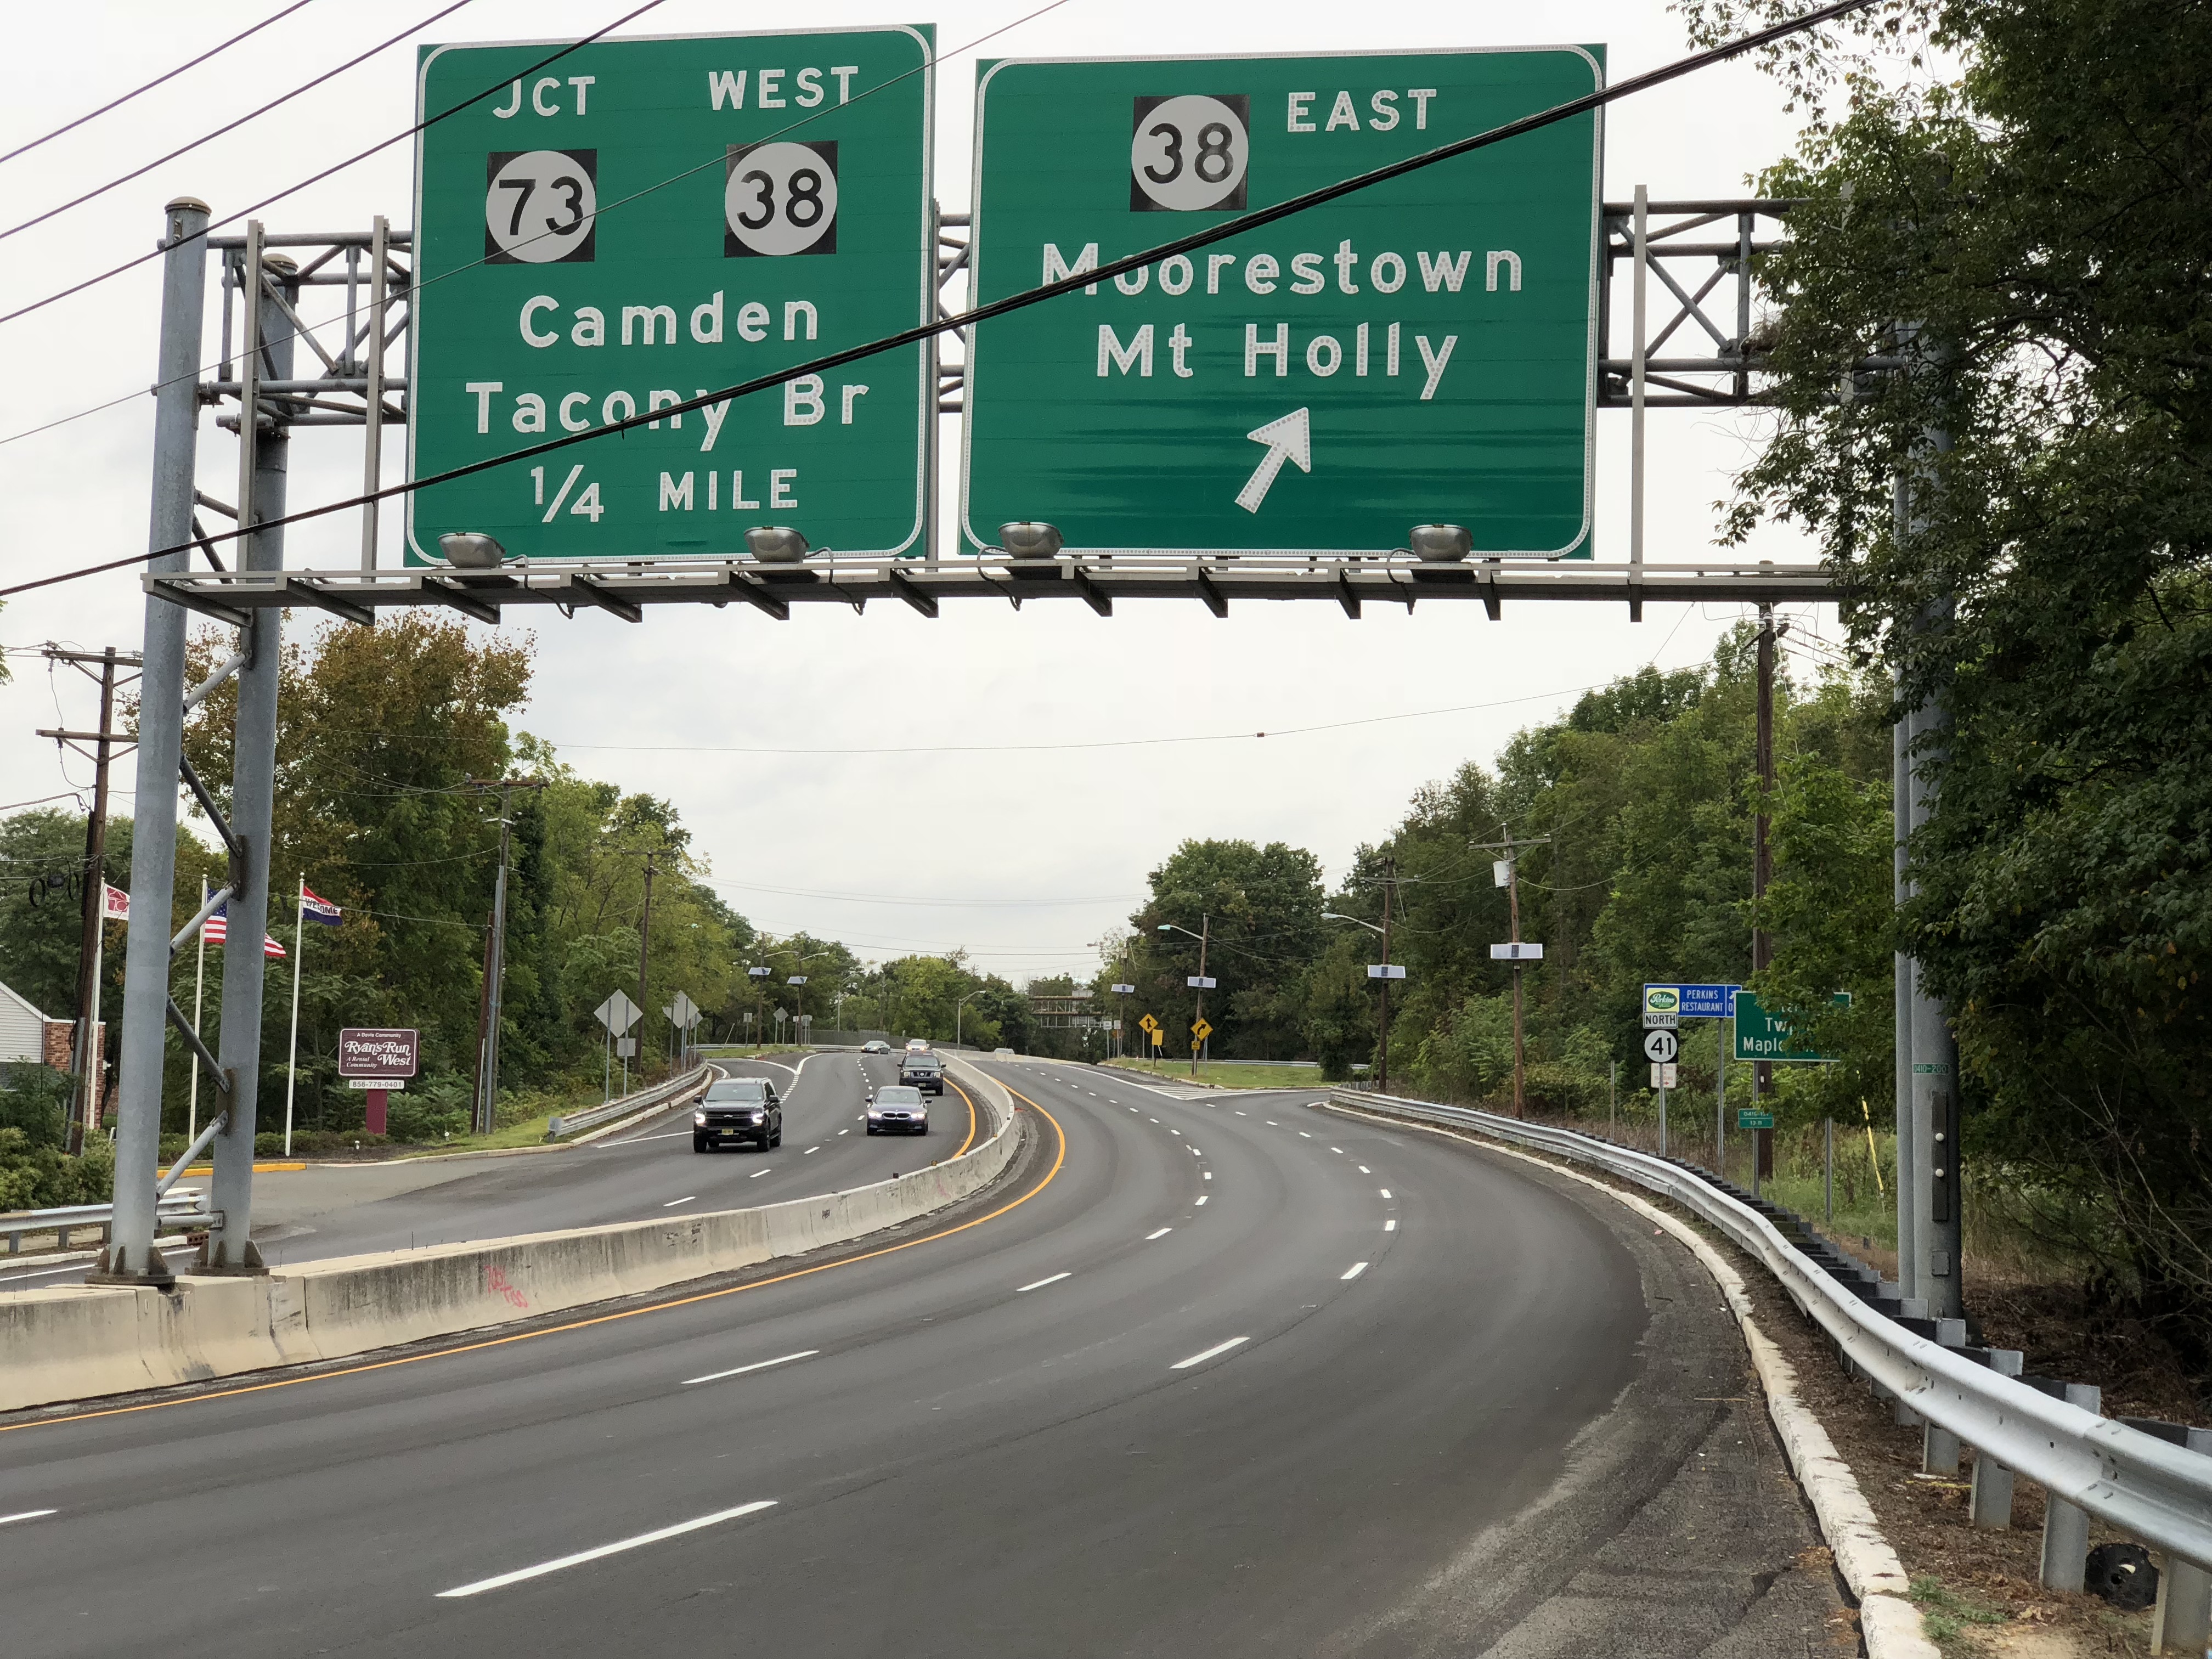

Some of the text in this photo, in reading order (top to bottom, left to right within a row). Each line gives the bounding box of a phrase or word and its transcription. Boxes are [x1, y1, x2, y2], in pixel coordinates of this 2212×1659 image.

[493, 76, 596, 119] JCT
[708, 65, 859, 110] WEST
[1286, 88, 1438, 133] EAST
[1143, 122, 1235, 184] 38
[498, 176, 584, 236] 73
[737, 168, 825, 230] 38
[1042, 239, 1523, 296] Moorestown
[518, 290, 818, 348] Camden
[1096, 321, 1459, 400] Mt Holly
[465, 374, 870, 452] Tacony Br
[531, 464, 799, 523] 1/4 MILE
[305, 898, 337, 914] WELOME
[1650, 993, 1675, 1003] Perkins
[1681, 1002, 1723, 1012] RESTAURANT
[1686, 990, 1718, 1000] PERKINS
[1645, 1015, 1675, 1025] NORTH
[345, 1041, 411, 1056] Ryan's Run
[377, 1054, 411, 1065] West
[1650, 1037, 1672, 1056] 41
